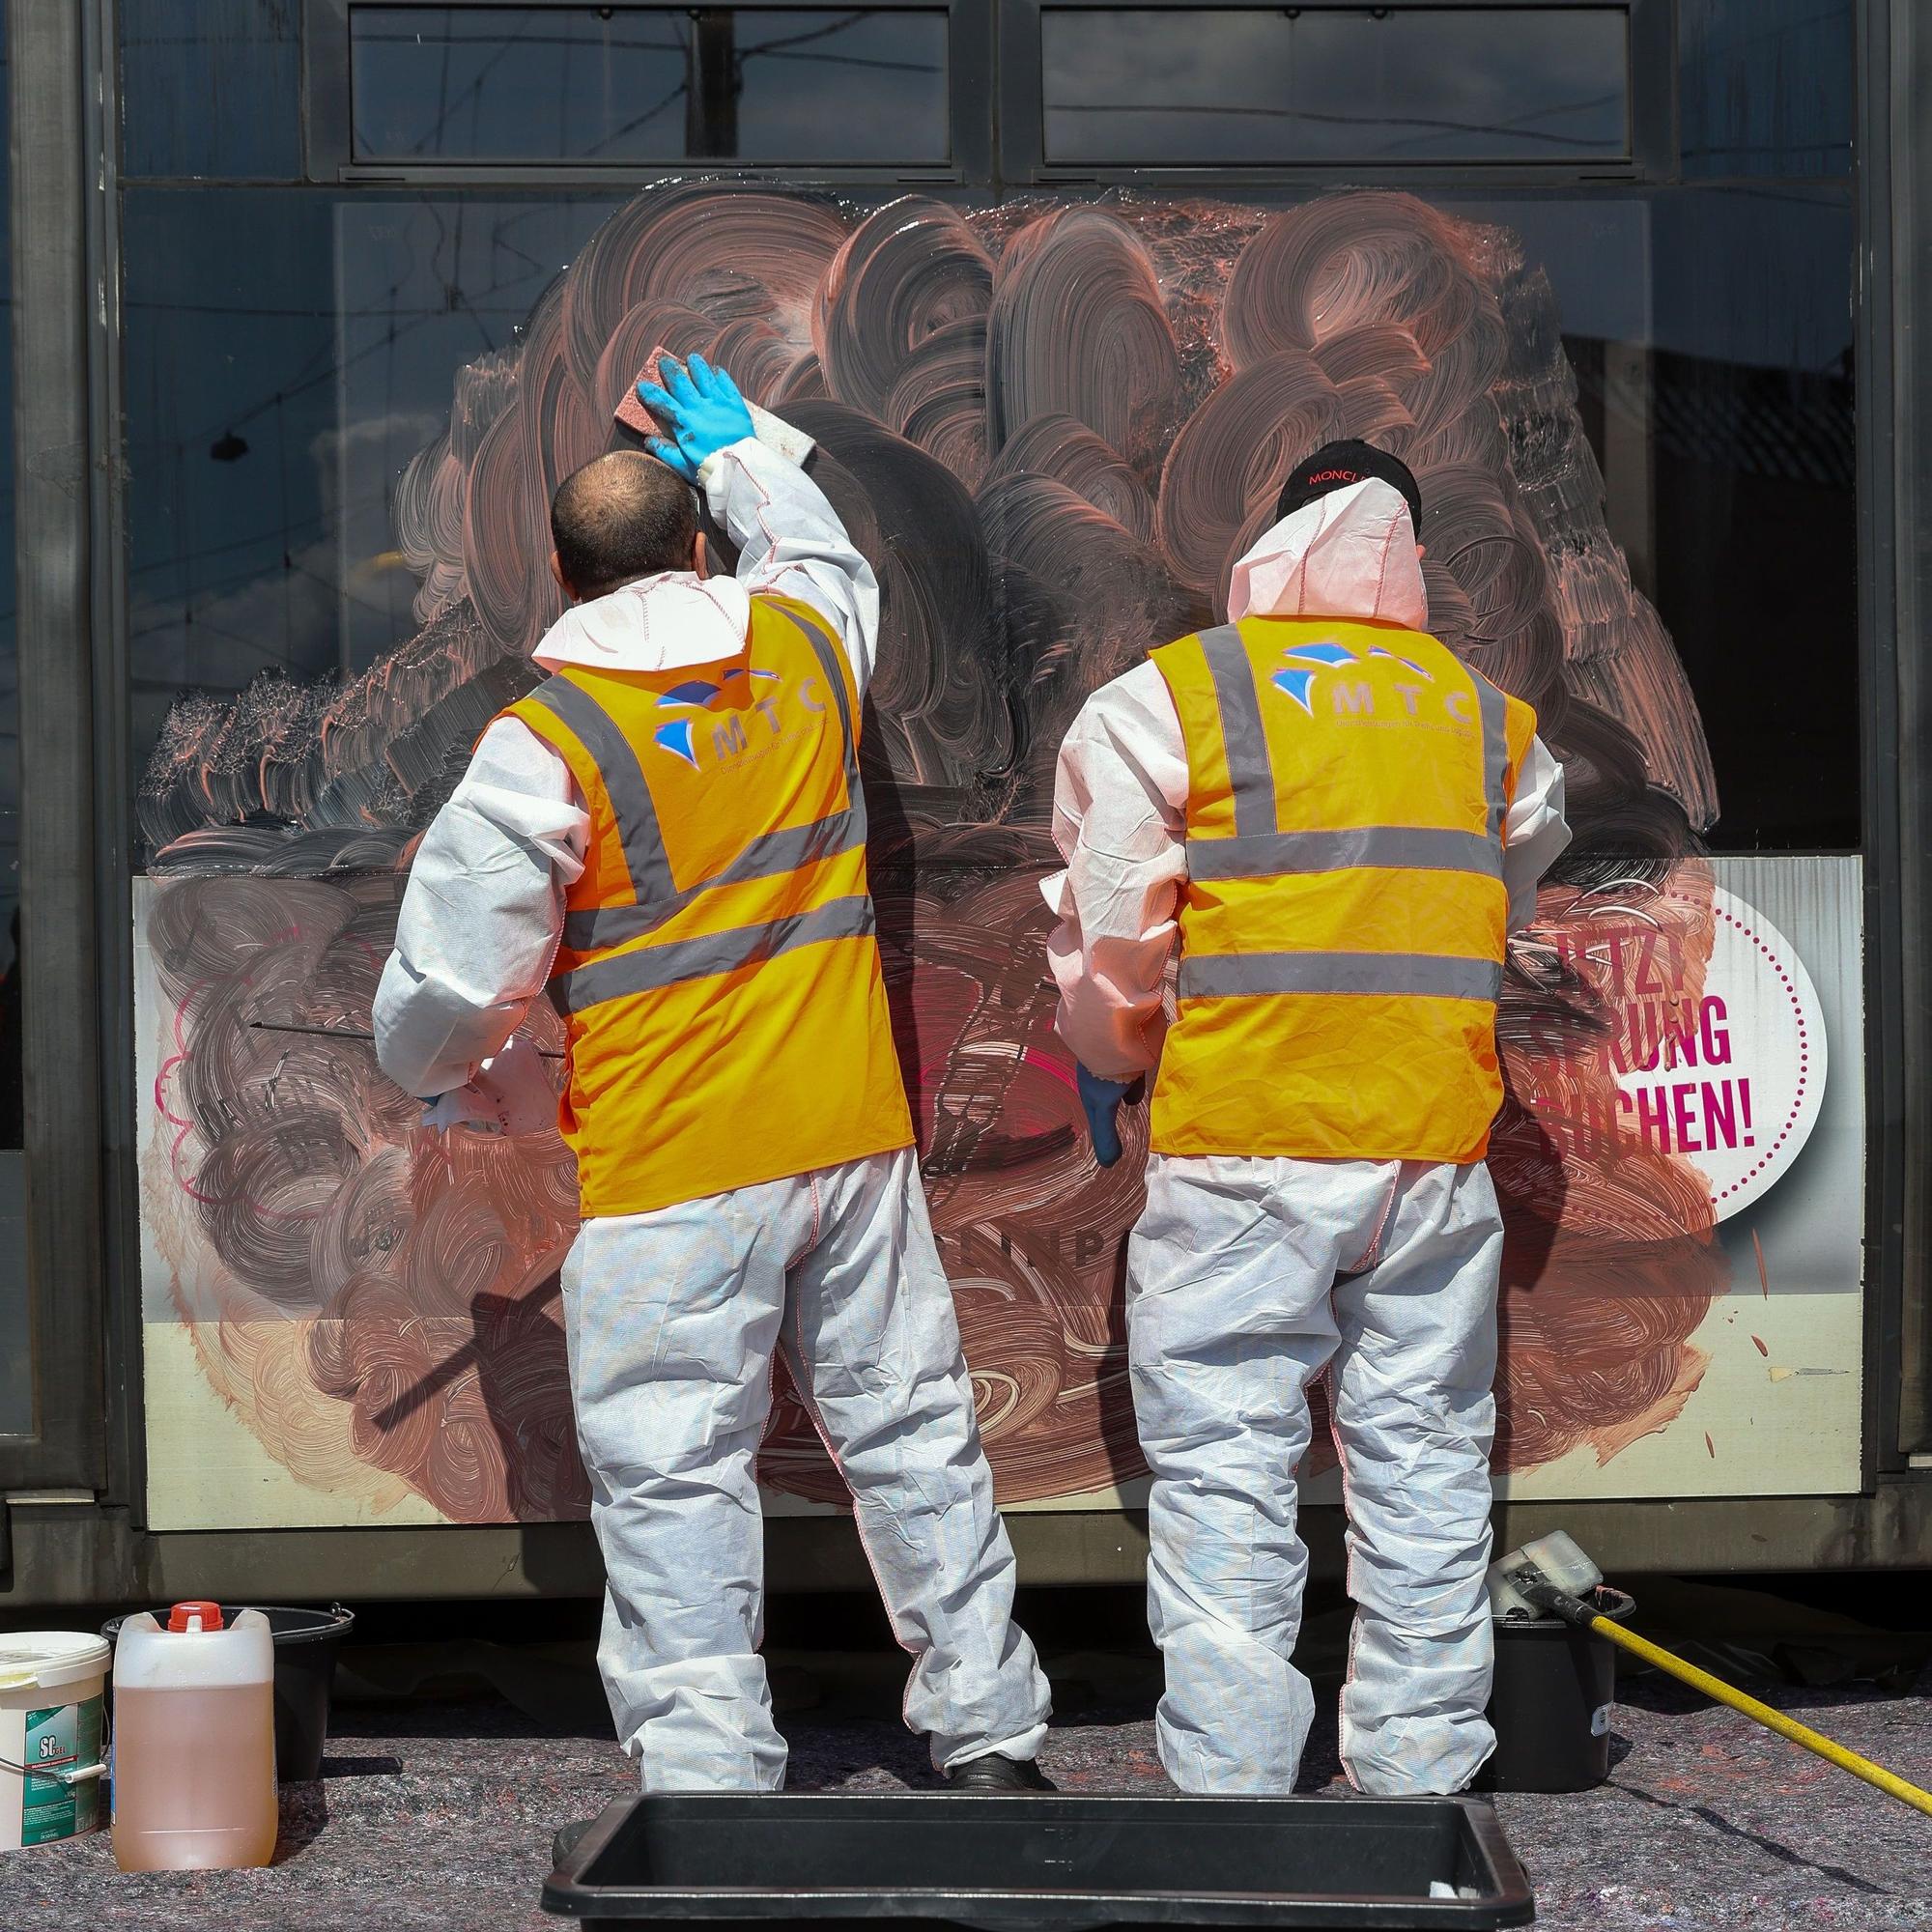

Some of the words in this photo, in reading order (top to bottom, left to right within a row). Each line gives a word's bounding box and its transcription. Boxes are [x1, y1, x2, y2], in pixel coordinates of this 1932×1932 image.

[712, 677, 826, 760] MTC
[1332, 682, 1473, 724] MTC
[40, 1735, 56, 1759] SC
